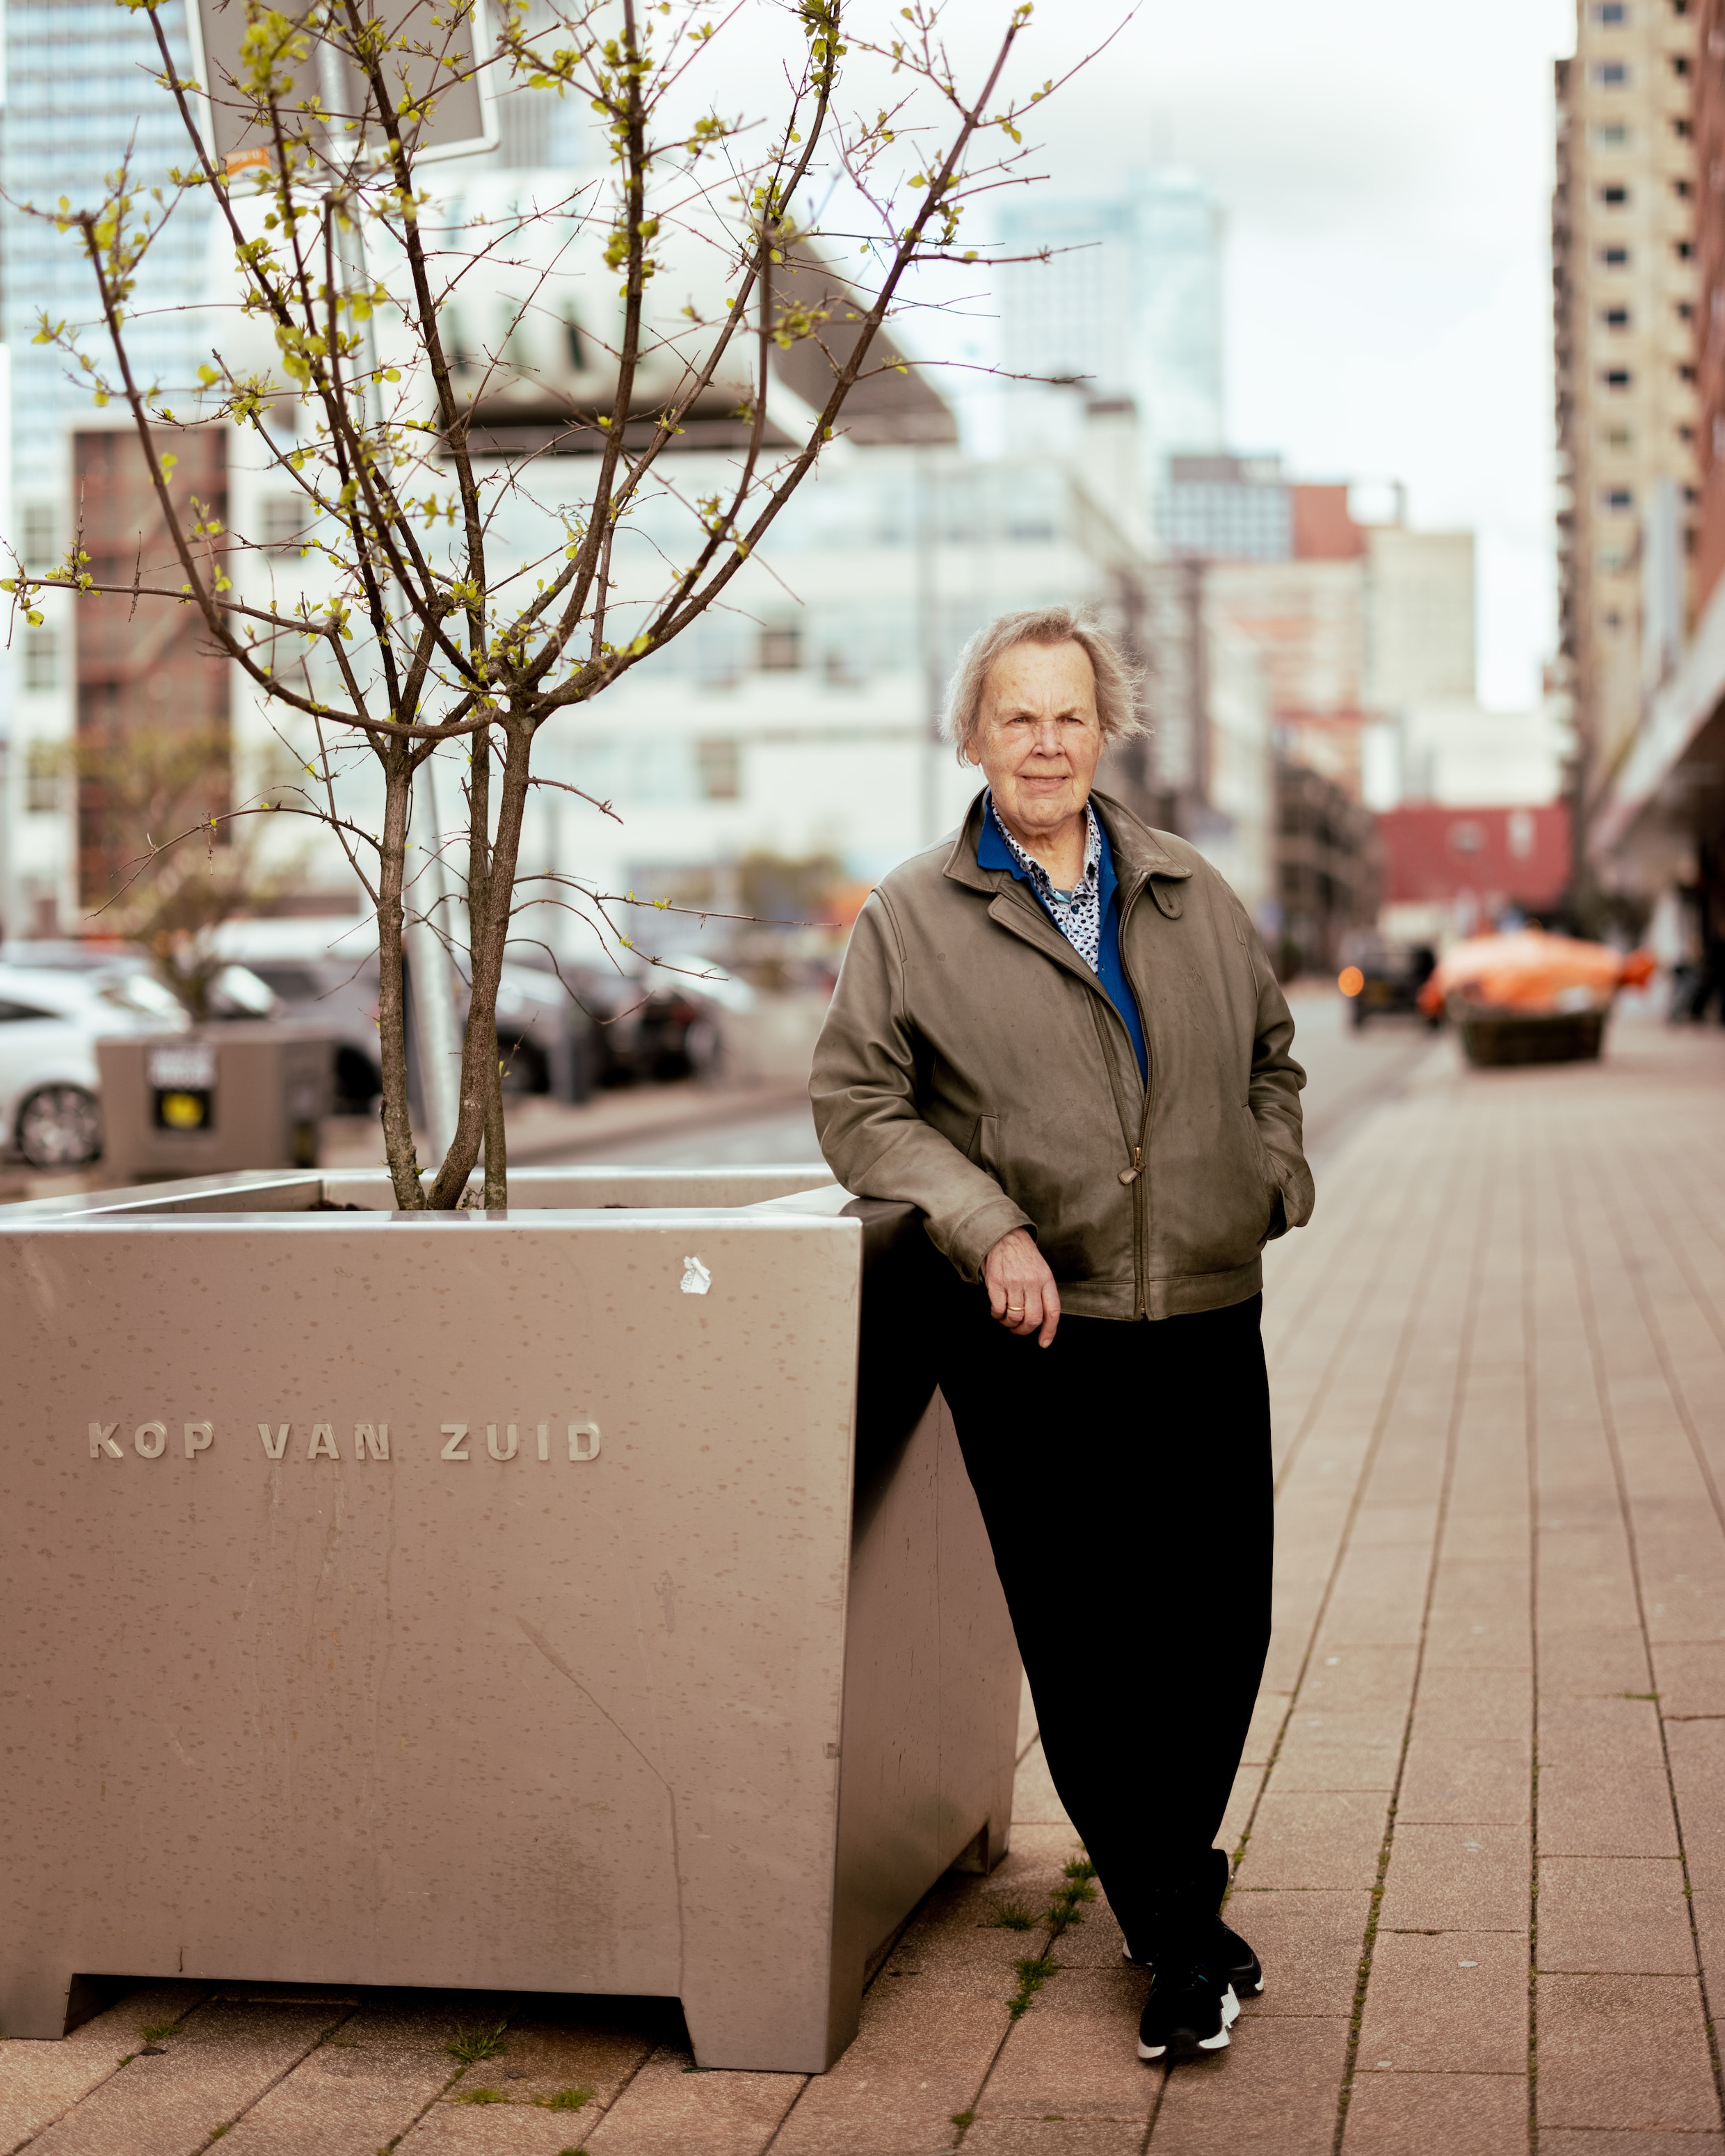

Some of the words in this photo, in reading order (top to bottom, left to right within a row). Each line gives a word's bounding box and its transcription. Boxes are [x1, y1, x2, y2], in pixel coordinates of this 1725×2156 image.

[88, 1422, 215, 1458] KOP
[257, 1423, 391, 1460] VAN
[440, 1423, 602, 1461] ZUID
